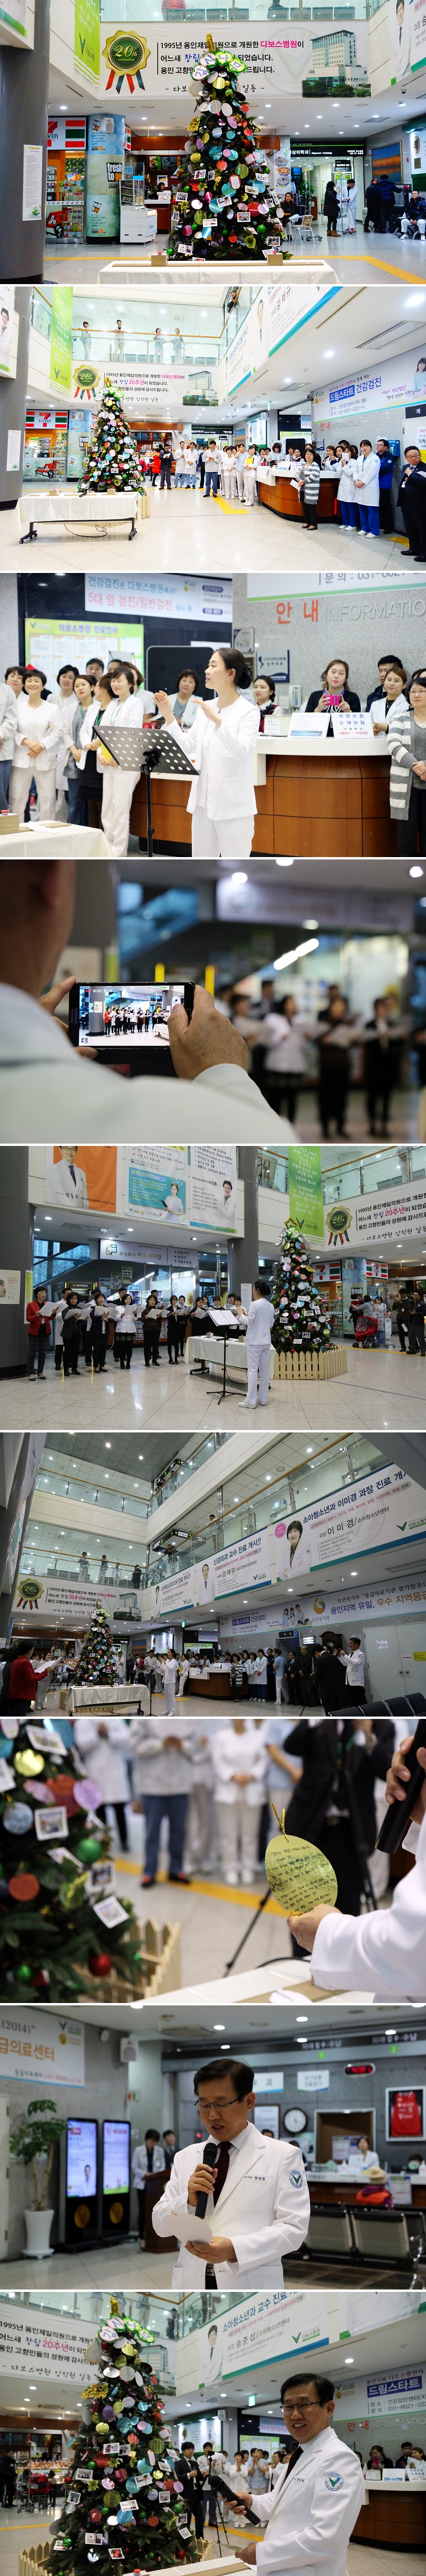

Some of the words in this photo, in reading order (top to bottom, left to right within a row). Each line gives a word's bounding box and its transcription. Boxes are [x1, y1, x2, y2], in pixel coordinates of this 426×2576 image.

[185, 54, 199, 63] 창립
[242, 84, 256, 92] 일동
[107, 163, 122, 172] fresh
[115, 173, 121, 182] go
[330, 386, 354, 401] 드림스타트
[356, 376, 382, 393] 건강검진
[339, 379, 355, 388] 다보스병원이
[88, 576, 125, 589] 건강검진은
[88, 592, 103, 605] 5대
[106, 594, 115, 607] 암
[118, 595, 172, 611] 검진/일반검진
[59, 624, 90, 633] 다보스병원
[94, 625, 118, 634] 진료안내
[373, 1197, 411, 1210] 용인제일의원으로
[368, 1219, 390, 1228] 고향민들의
[367, 1232, 392, 1241] 다보스병원
[137, 1252, 161, 1261] 바로메디칼
[303, 1503, 336, 1524] 소아청소년과
[337, 1493, 357, 1507] 이미경
[359, 1485, 373, 1497] 과장
[376, 1477, 392, 1490] 진료
[213, 1554, 228, 1565] 신경외과
[229, 1549, 237, 1558] 교수
[239, 1545, 247, 1554] 진료
[248, 1537, 261, 1548] 개시!!
[338, 1595, 360, 1603] 보건복지부
[331, 1603, 356, 1615] 용인지역
[358, 1601, 375, 1610] 유일,
[377, 1597, 393, 1606] 우수
[222, 2306, 256, 2332] 소아청소년과
[257, 2299, 271, 2313] 교수
[0, 2322, 23, 2332] 1995년
[25, 2326, 77, 2342] 용인제일의원으로
[302, 2328, 320, 2339] 다보스병원
[0, 2333, 21, 2343] 어느새
[25, 2336, 41, 2347] 창립
[43, 2338, 75, 2352] 20주년이
[15, 2346, 49, 2359] 고향민들의
[51, 2353, 70, 2362] 성원에
[11, 2365, 50, 2376] 다보스병원
[55, 2370, 75, 2379] 임직원
[80, 2373, 91, 2381] 일동
[367, 2377, 386, 2385] 용인시와
[389, 2369, 424, 2380] 다보스병원이
[369, 2378, 420, 2396] 드림스타트
